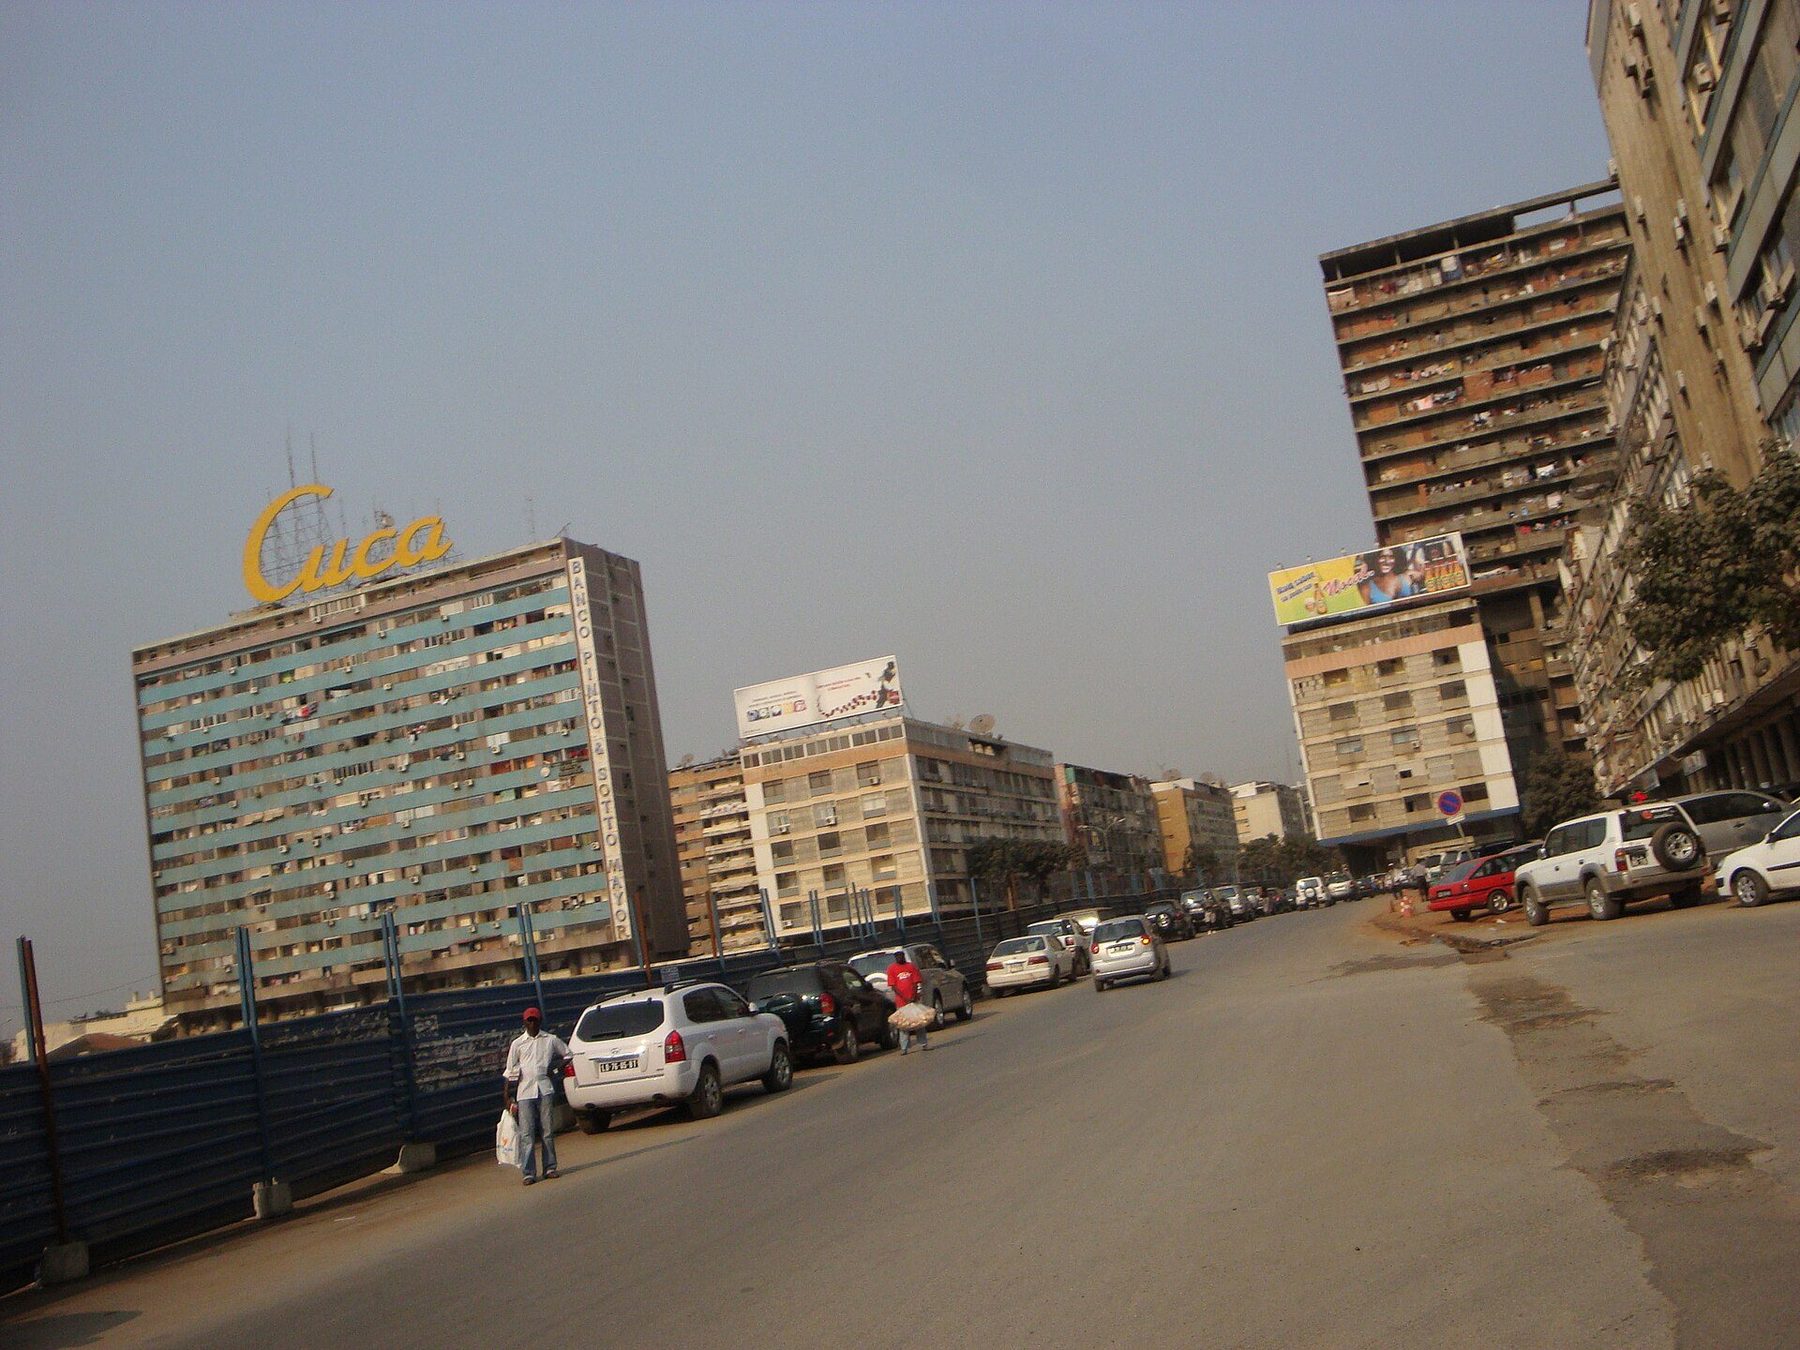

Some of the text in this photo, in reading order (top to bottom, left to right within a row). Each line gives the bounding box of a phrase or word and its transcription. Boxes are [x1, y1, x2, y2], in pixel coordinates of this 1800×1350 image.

[242, 484, 454, 602] Cuca
[572, 561, 590, 638] BANCO
[583, 651, 602, 730] PINTO
[598, 767, 617, 846] SOTTO
[608, 858, 631, 940] MAYOR
